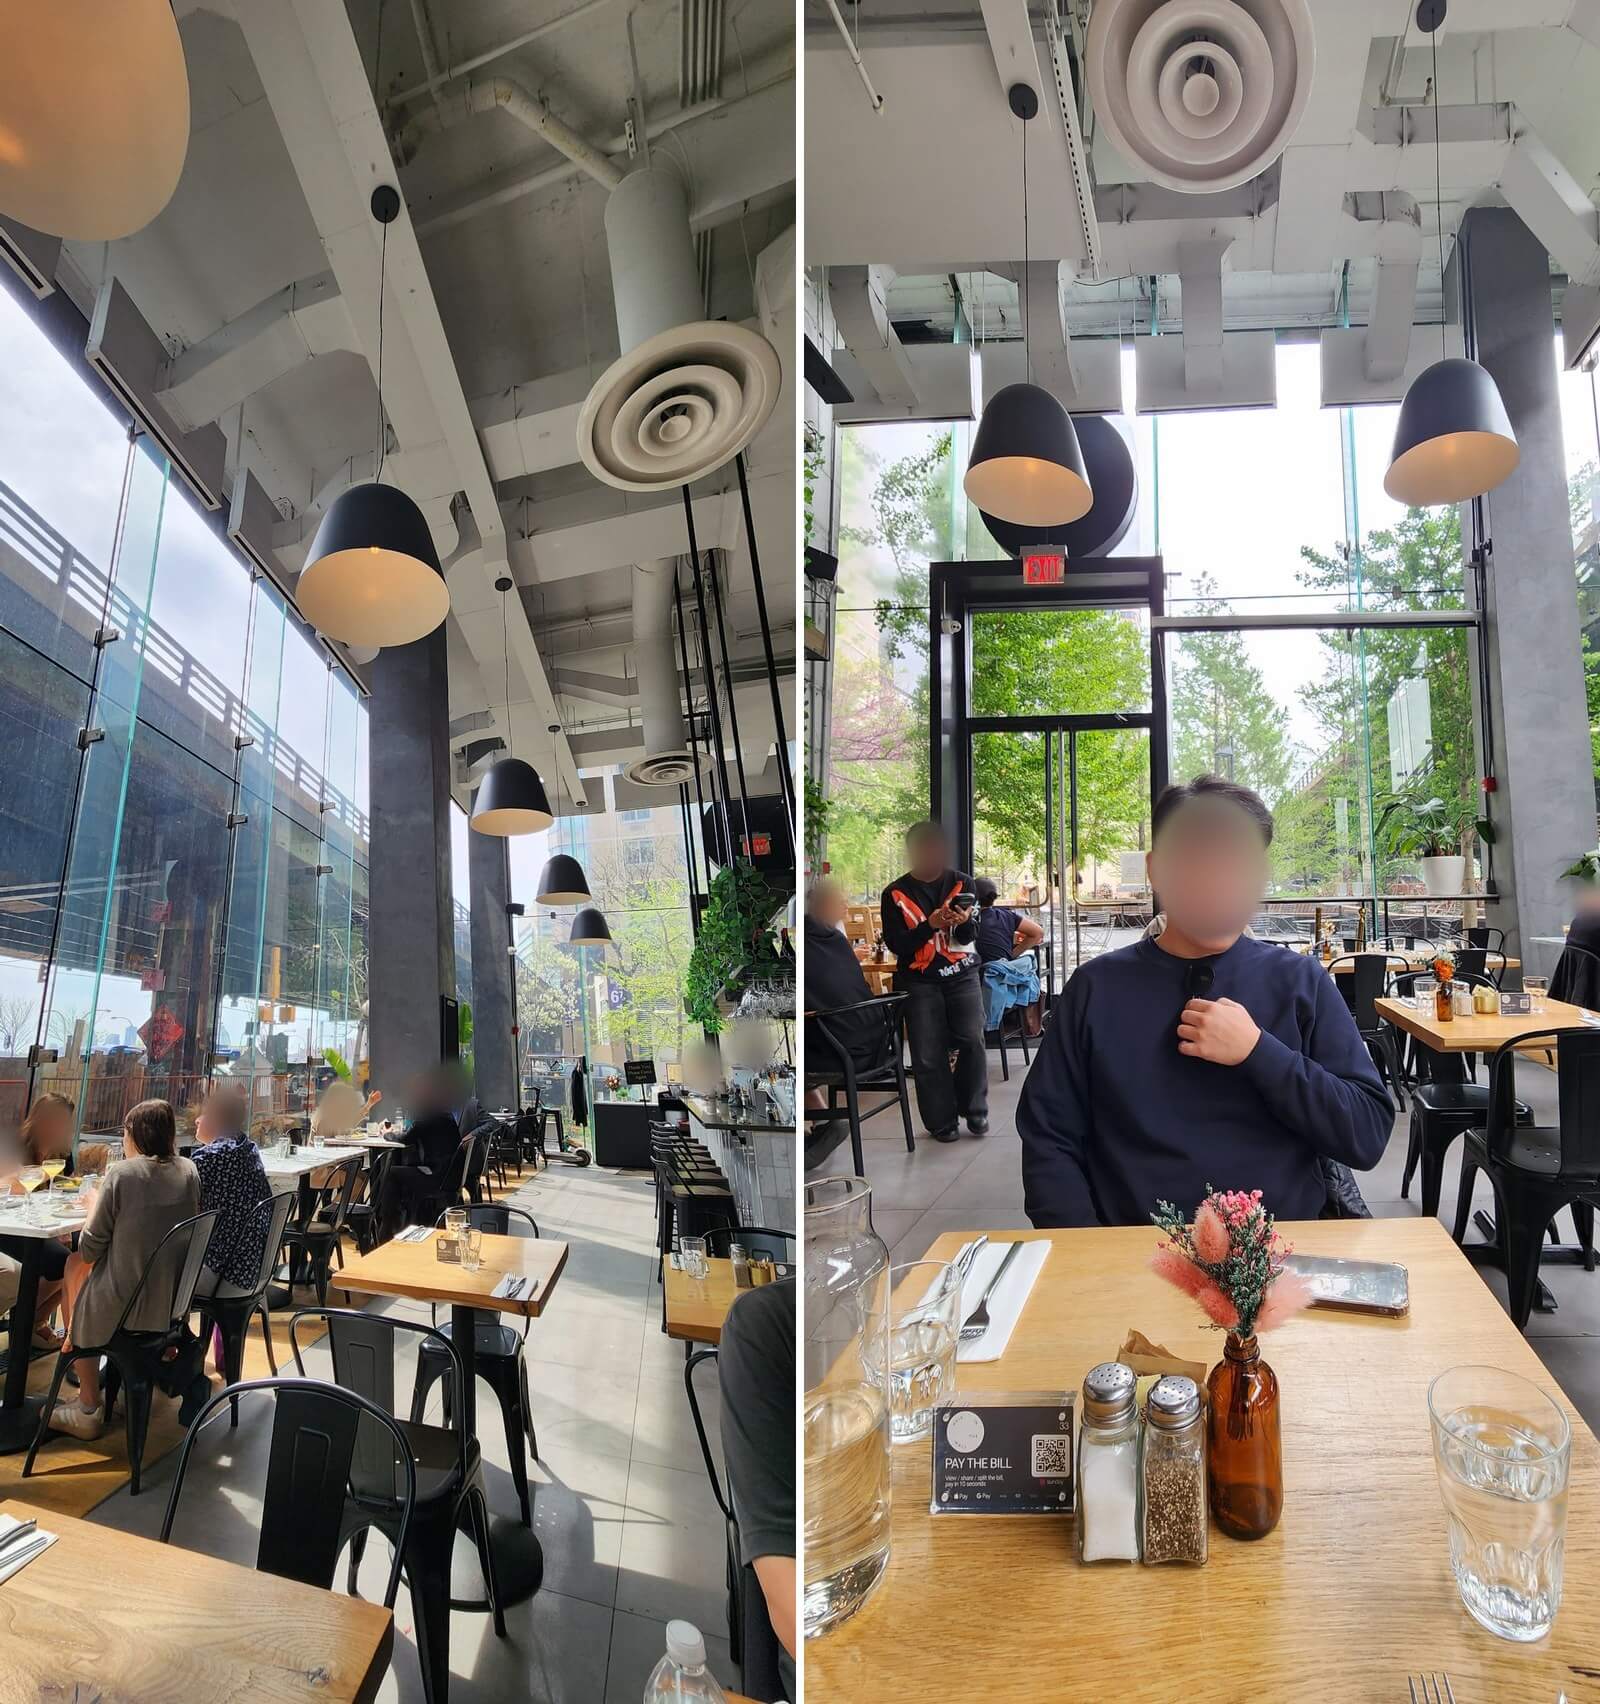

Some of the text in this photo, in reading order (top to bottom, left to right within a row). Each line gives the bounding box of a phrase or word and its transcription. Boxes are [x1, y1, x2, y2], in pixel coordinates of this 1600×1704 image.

[1026, 555, 1061, 580] EXIT
[1059, 1422, 1069, 1430] 33
[945, 1457, 1012, 1469] PAY THE BILL
